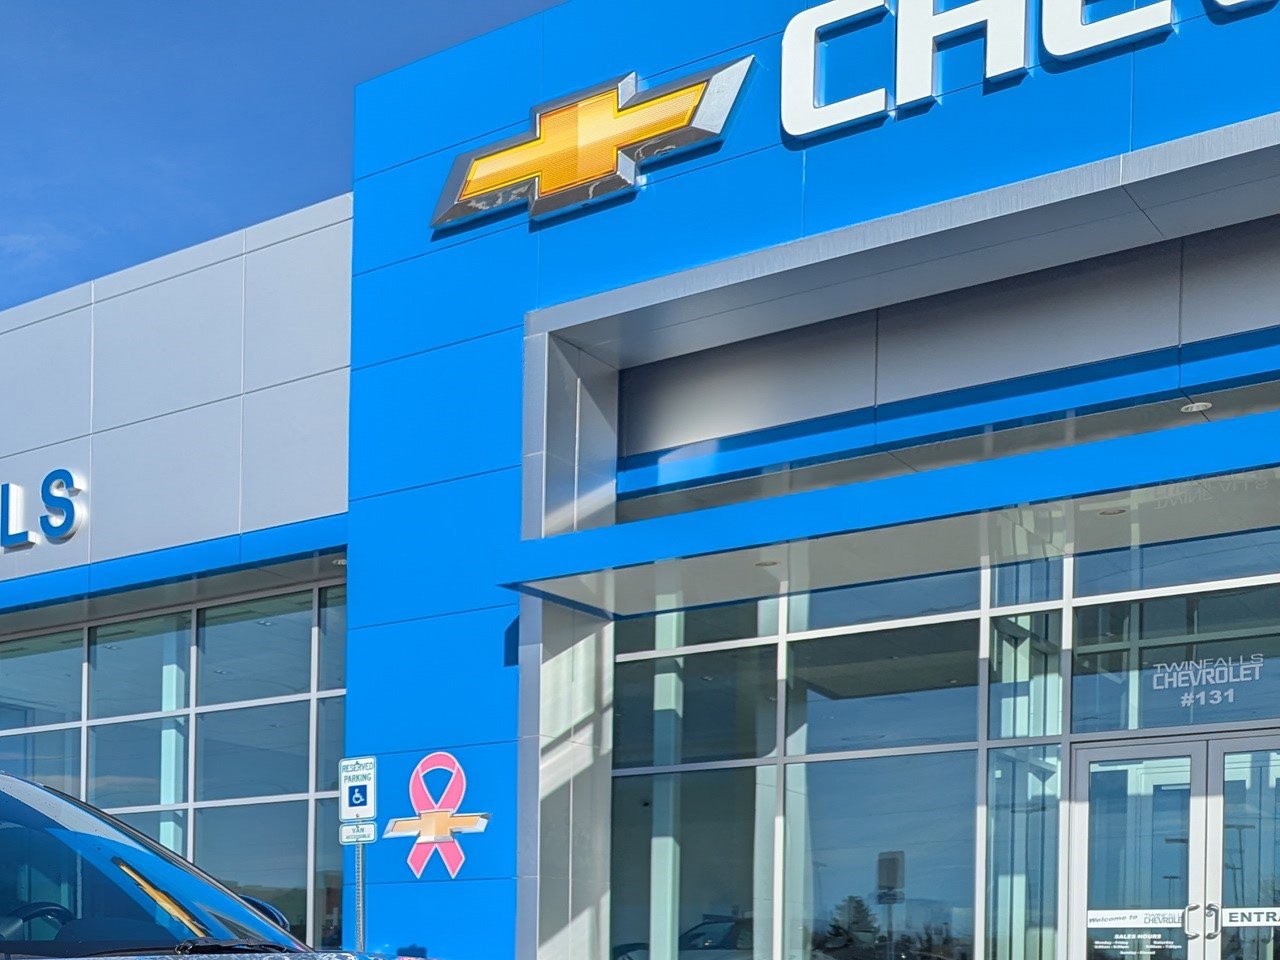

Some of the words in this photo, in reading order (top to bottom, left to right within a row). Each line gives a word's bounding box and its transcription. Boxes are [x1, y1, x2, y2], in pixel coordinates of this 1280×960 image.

[781, 0, 1256, 136] CH
[1153, 663, 1264, 690] CHEVROLET
[1181, 688, 1234, 707] #131
[341, 762, 374, 773] RESERVED
[344, 773, 371, 783] PARKING
[1229, 911, 1280, 922] ENTR
